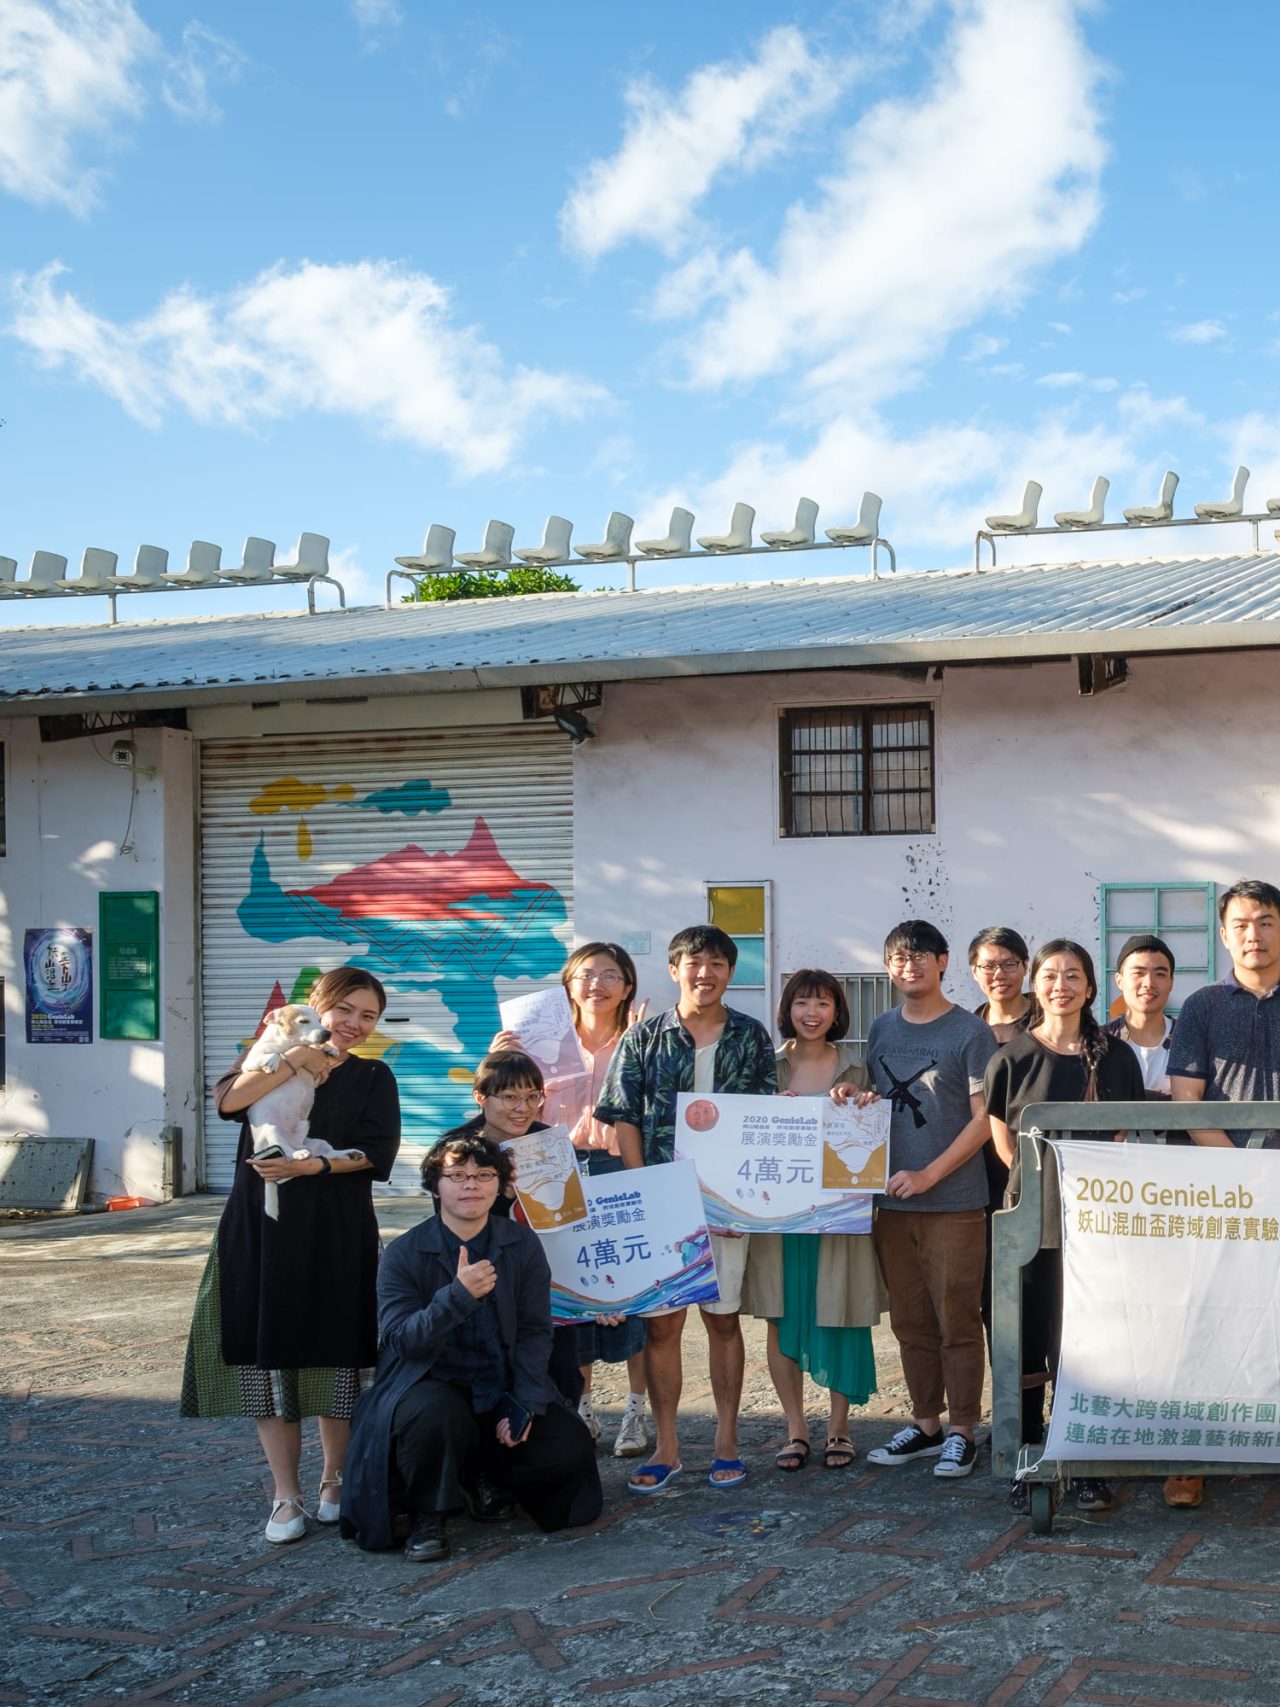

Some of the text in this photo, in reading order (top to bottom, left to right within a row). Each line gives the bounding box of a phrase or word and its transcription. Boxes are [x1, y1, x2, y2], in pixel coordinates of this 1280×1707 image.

[743, 1115, 818, 1125] 2020 GenieLab
[741, 1131, 818, 1147] 展演獎勵金
[737, 1156, 815, 1185] 4萬元
[595, 1190, 642, 1206] GenieLab
[1076, 1177, 1254, 1209] 2020 GenieLab
[576, 1234, 652, 1270] 4萬元
